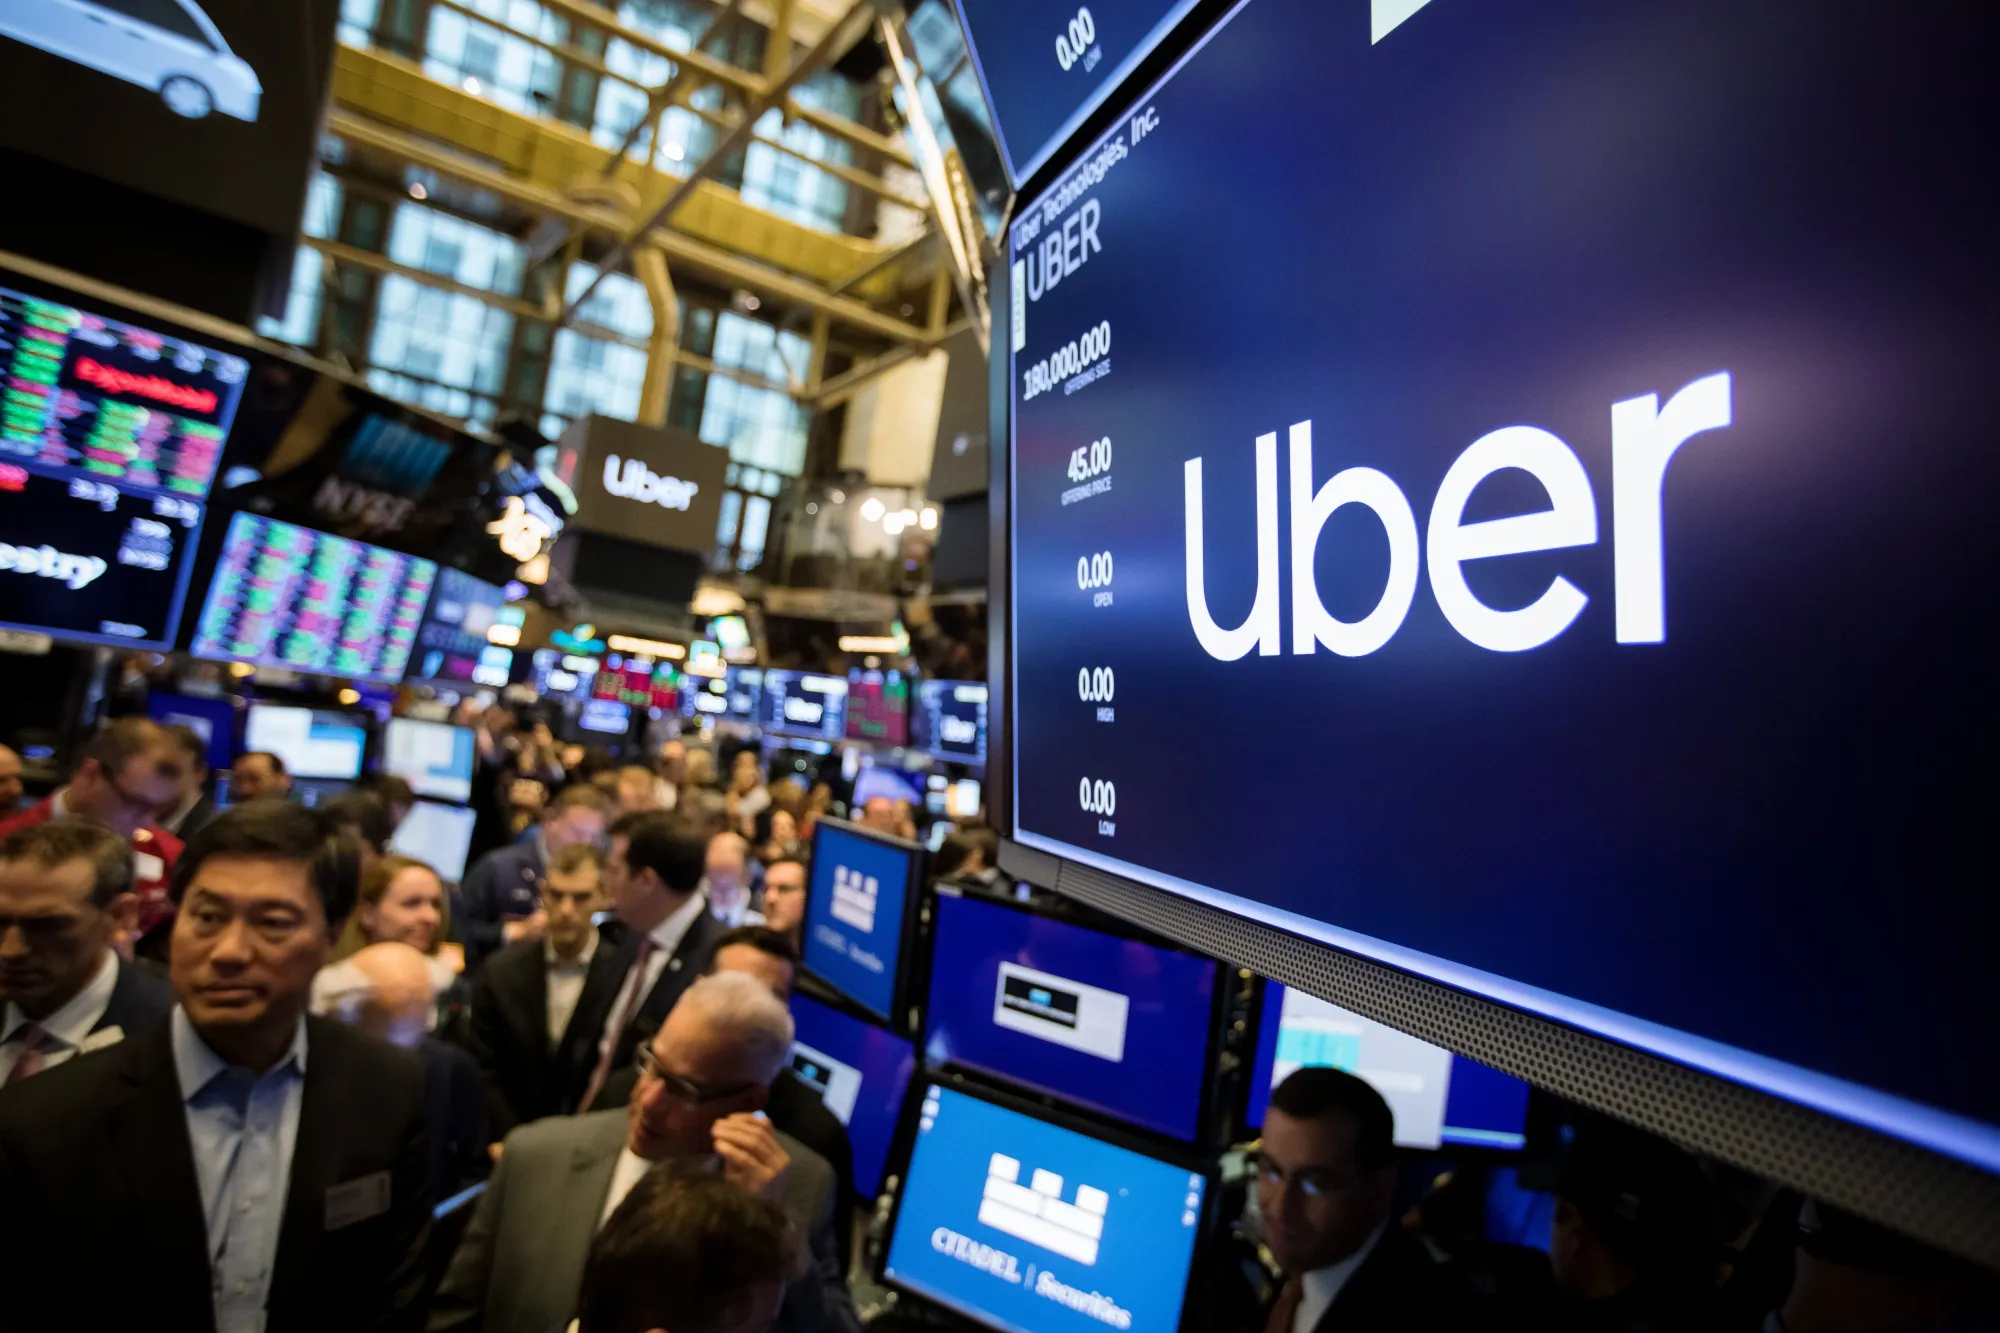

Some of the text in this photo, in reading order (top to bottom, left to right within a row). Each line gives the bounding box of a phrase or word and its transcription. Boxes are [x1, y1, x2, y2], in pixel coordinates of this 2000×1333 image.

[1056, 7, 1096, 71] 0.00
[1015, 106, 1160, 250] Uber Technologies, Inc.
[1027, 198, 1102, 302] UBER
[1024, 320, 1111, 401] 180,000,000
[602, 454, 698, 512] Uber
[1067, 436, 1112, 482] 45.00
[1185, 371, 1732, 662] Uber
[1077, 551, 1113, 590] 0.00
[1093, 592, 1113, 607] OPEN
[1078, 666, 1114, 702] 0.00
[1097, 708, 1114, 722] HIGH
[1079, 776, 1116, 816] 0.00
[1099, 820, 1115, 837] LOW
[931, 1227, 1132, 1330] CITADEL Securities
